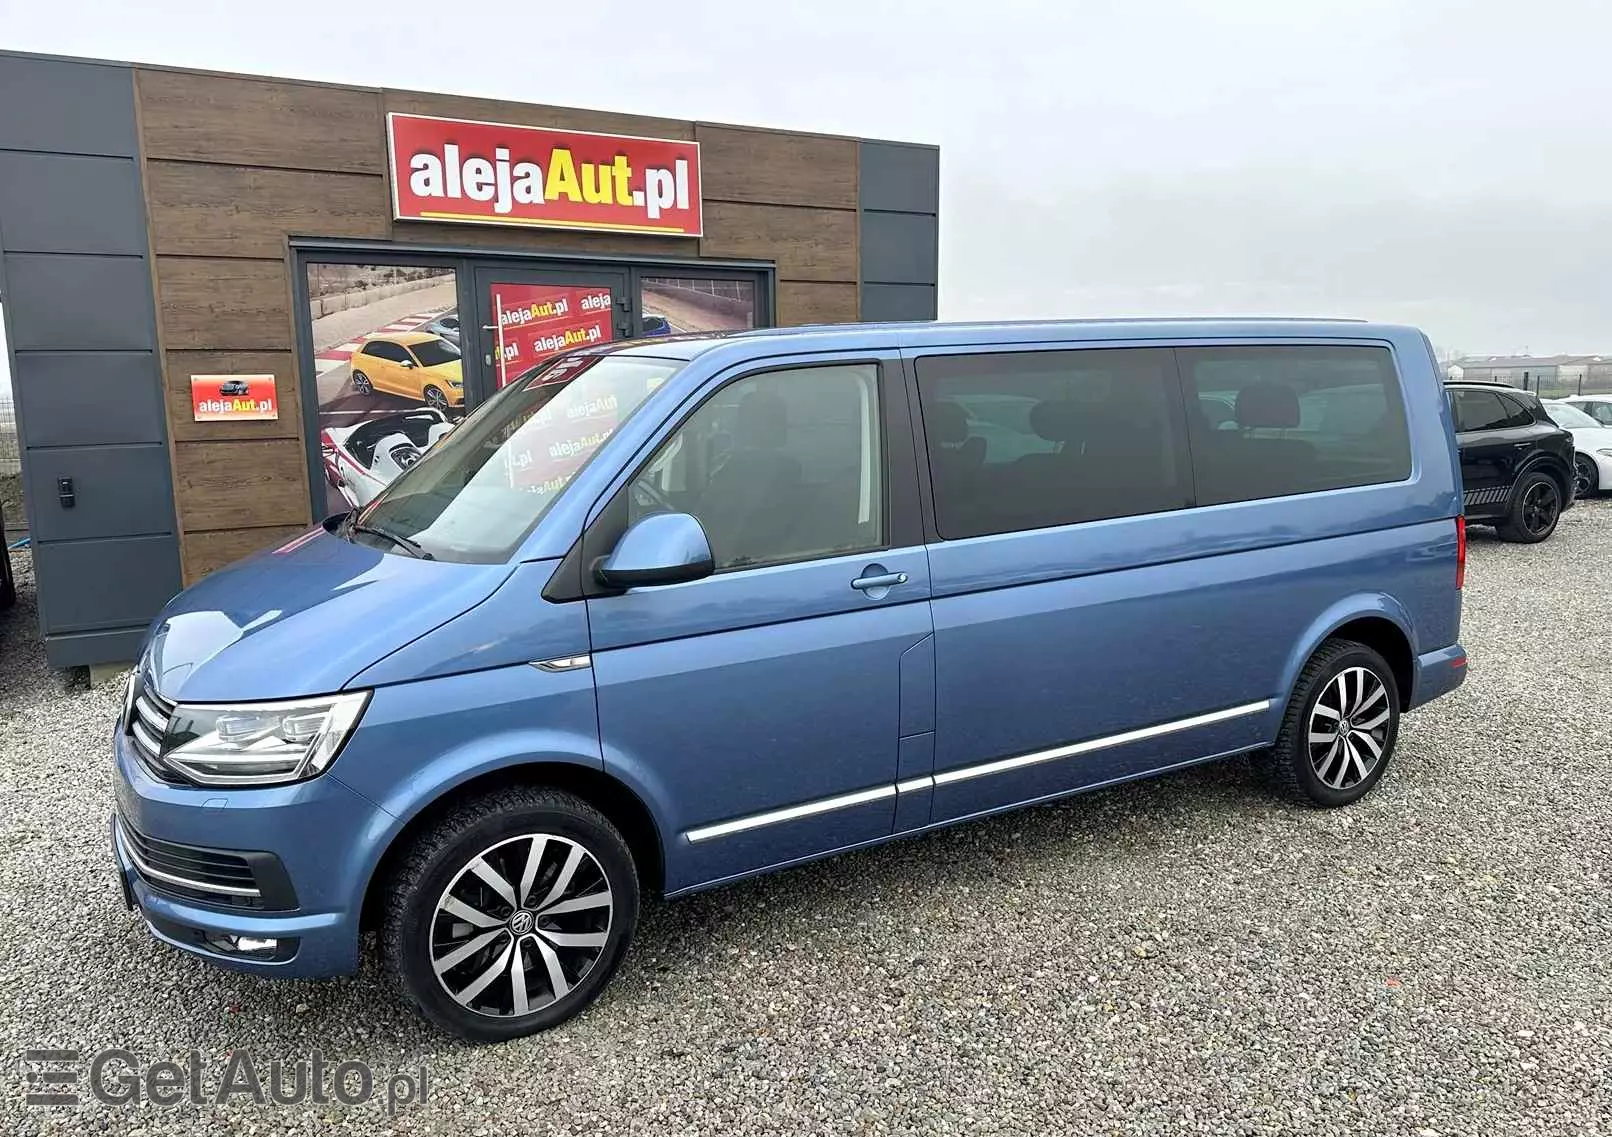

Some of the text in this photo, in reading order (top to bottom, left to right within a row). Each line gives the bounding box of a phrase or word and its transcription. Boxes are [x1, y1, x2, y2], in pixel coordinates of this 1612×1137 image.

[409, 143, 690, 219] alejaAut.pl
[534, 326, 601, 352] alejaAut.pl
[199, 399, 272, 413] alejaAut.pl
